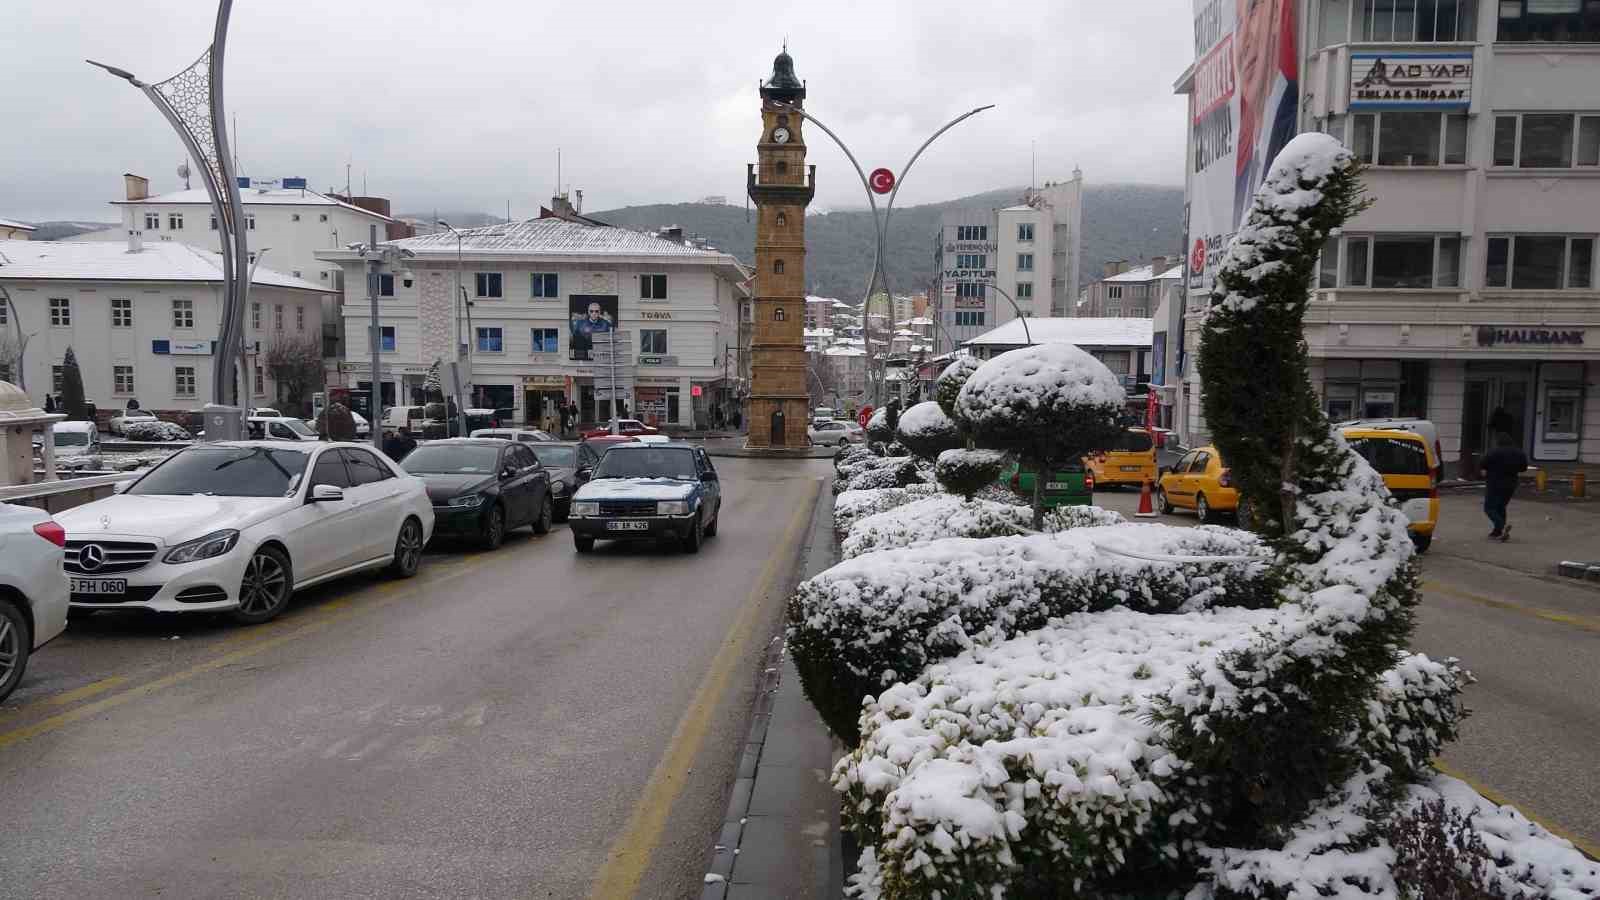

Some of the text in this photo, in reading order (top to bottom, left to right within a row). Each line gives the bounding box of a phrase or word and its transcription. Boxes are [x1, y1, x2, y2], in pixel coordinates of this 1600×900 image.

[1427, 64, 1470, 78] YAPI
[1358, 90, 1400, 99] EMLAK
[1496, 329, 1585, 344] HALKBANK
[80, 580, 96, 592] FH
[101, 581, 124, 592] 060
